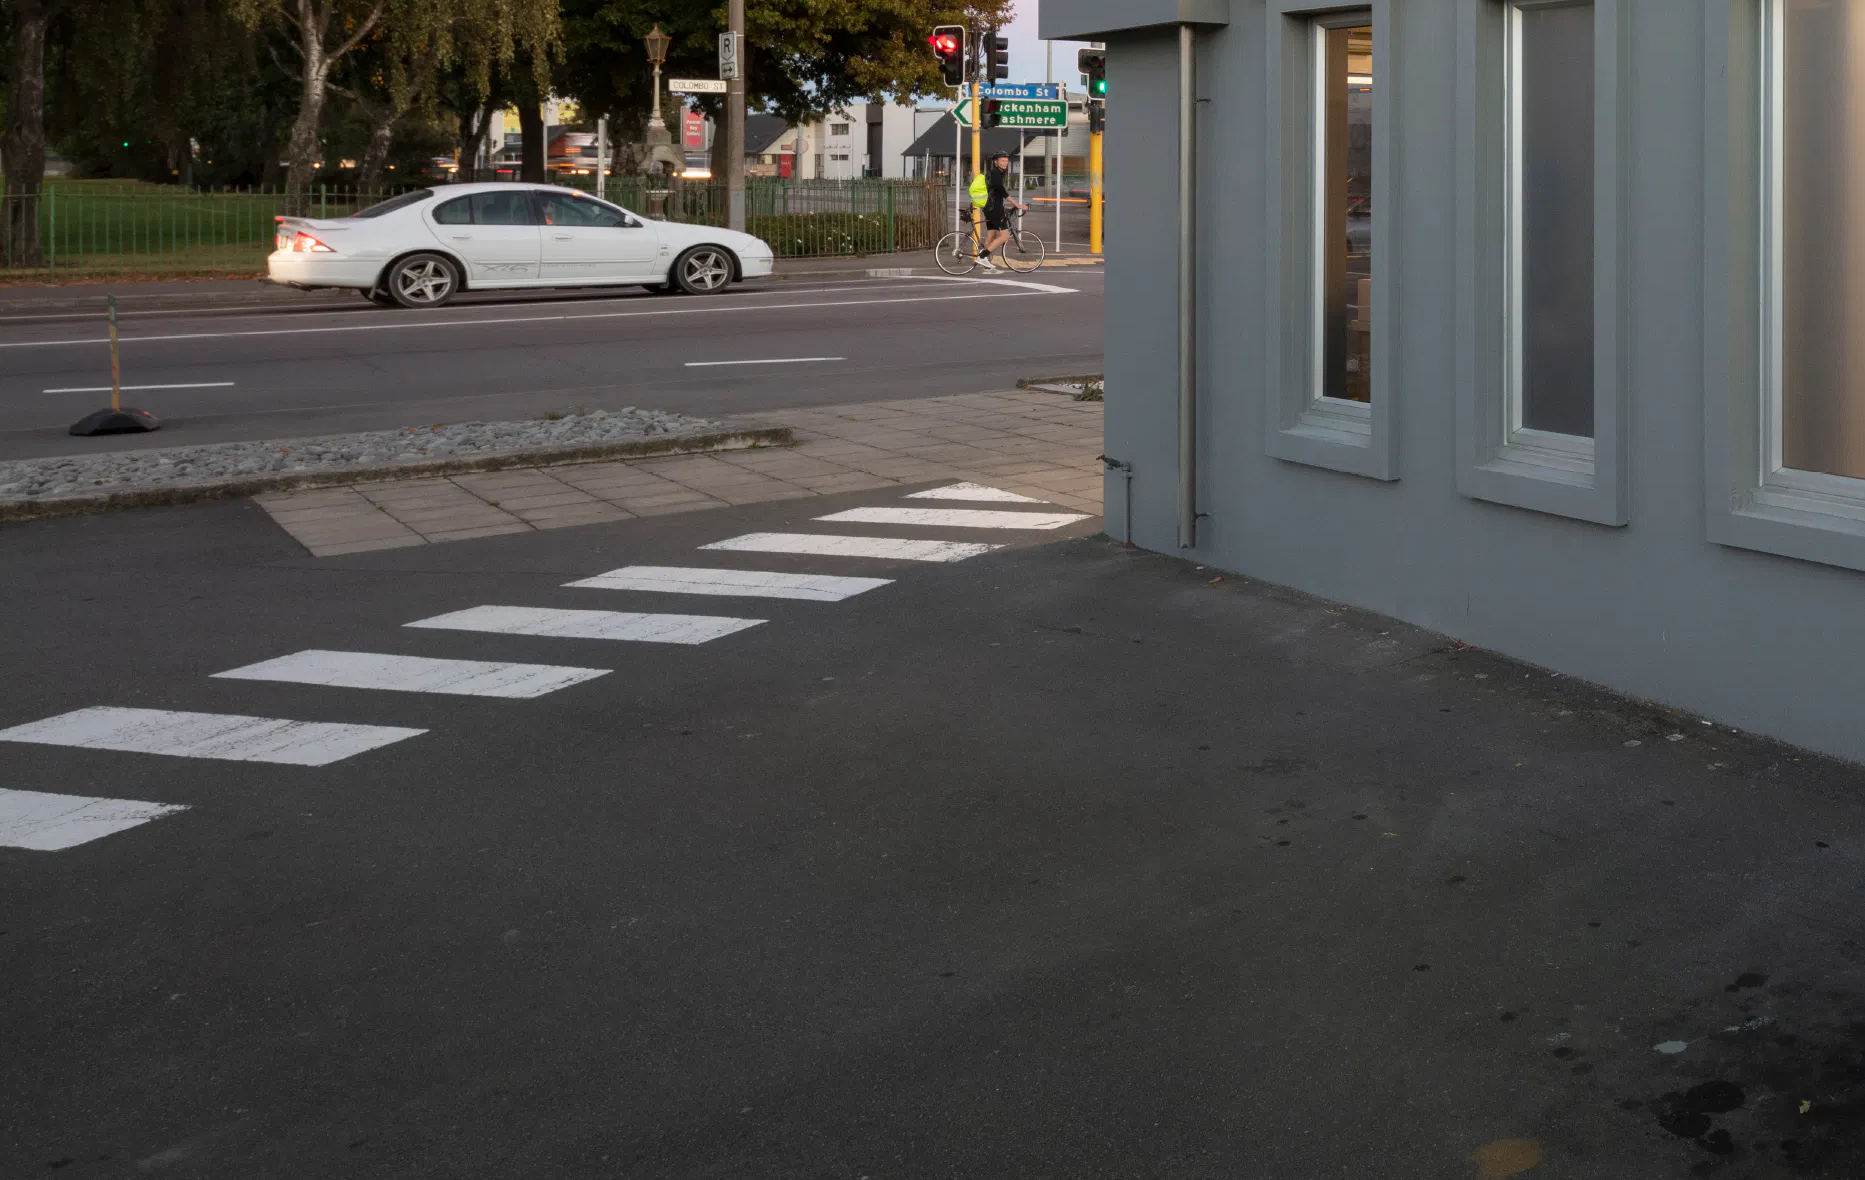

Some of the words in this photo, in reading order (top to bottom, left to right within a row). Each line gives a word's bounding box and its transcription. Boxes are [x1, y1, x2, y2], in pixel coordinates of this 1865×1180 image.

[673, 81, 709, 90] COLOMBO
[713, 82, 724, 91] ST
[978, 86, 1029, 96] Colombo
[1035, 87, 1049, 97] St
[999, 103, 1061, 113] ckenham
[1001, 115, 1057, 124] ashmere
